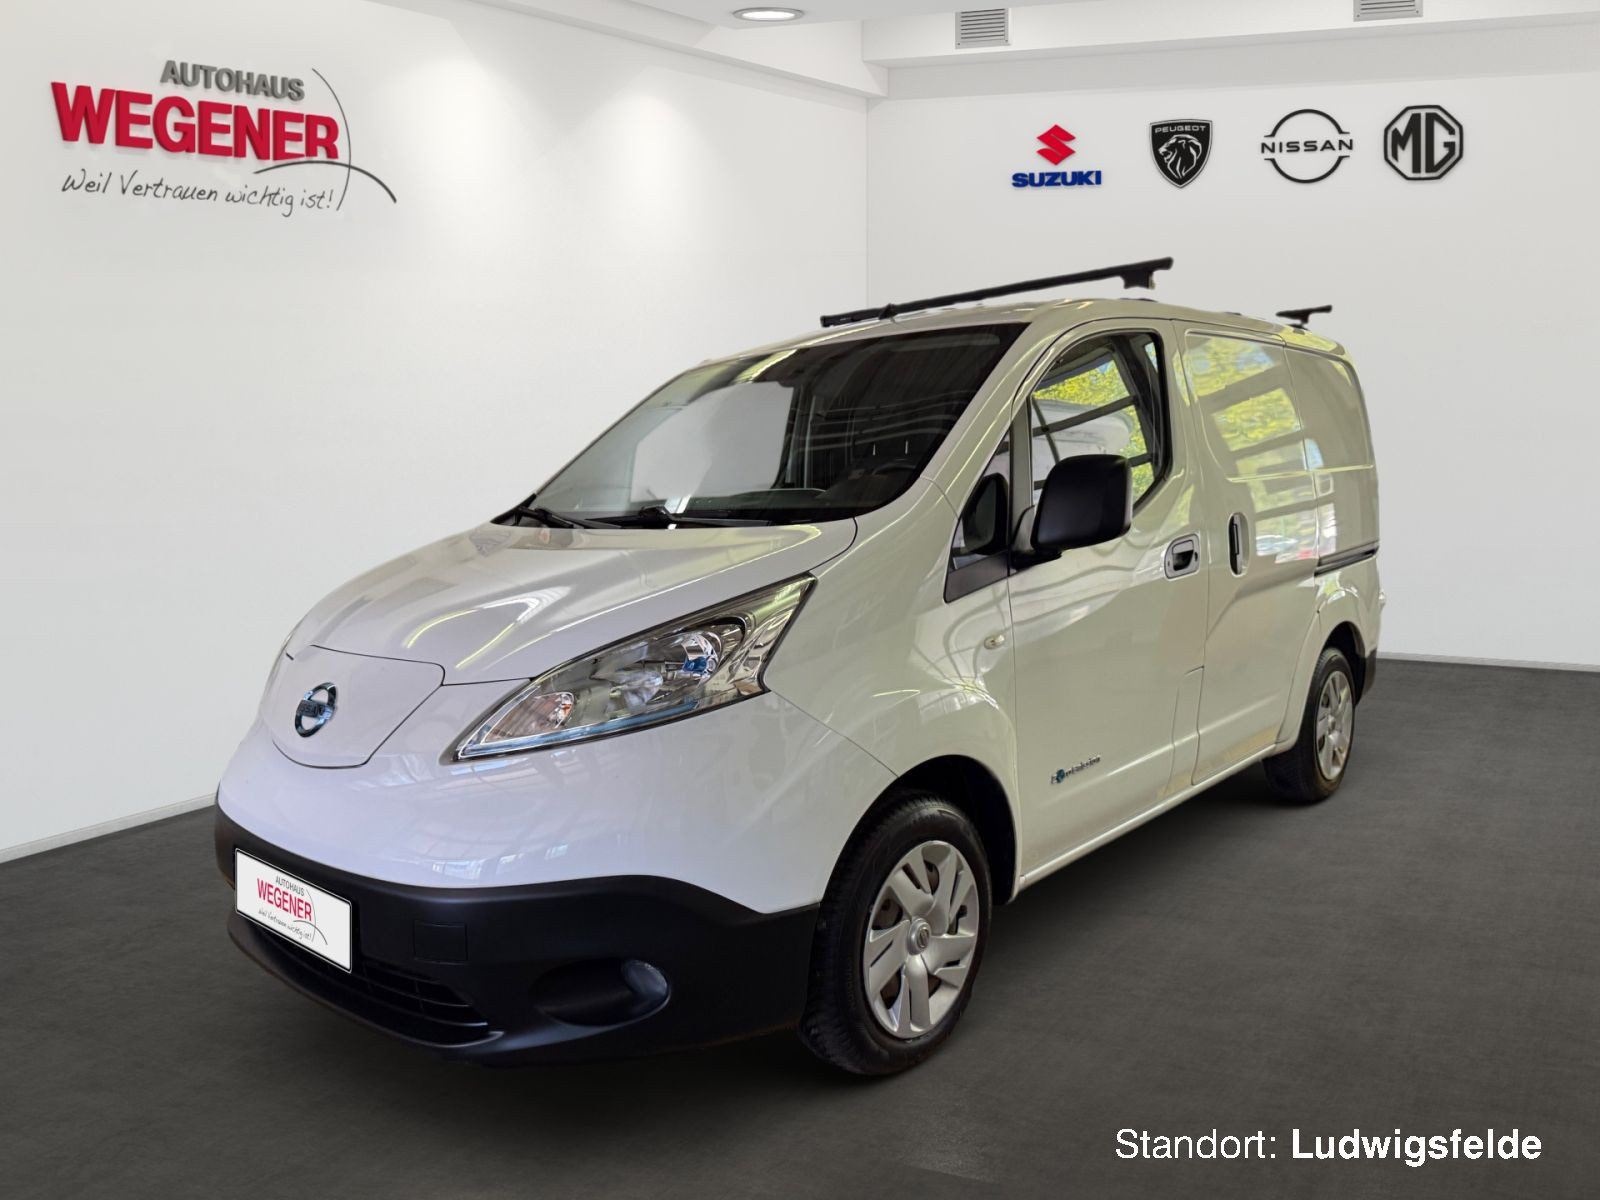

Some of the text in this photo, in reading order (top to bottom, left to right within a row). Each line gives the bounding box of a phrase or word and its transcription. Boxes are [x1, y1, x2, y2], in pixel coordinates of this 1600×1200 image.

[160, 60, 305, 101] AUTOHAUS
[51, 82, 341, 161] WEGENER
[1154, 125, 1206, 134] PEUGEOT
[1261, 138, 1354, 154] NISSAN
[1391, 112, 1456, 174] MG
[61, 168, 334, 217] Weil Vertrauen wichtig ist!
[1012, 170, 1102, 188] SUZUKI
[257, 878, 312, 921] WEGENER
[275, 876, 305, 896] AUTOHAUS
